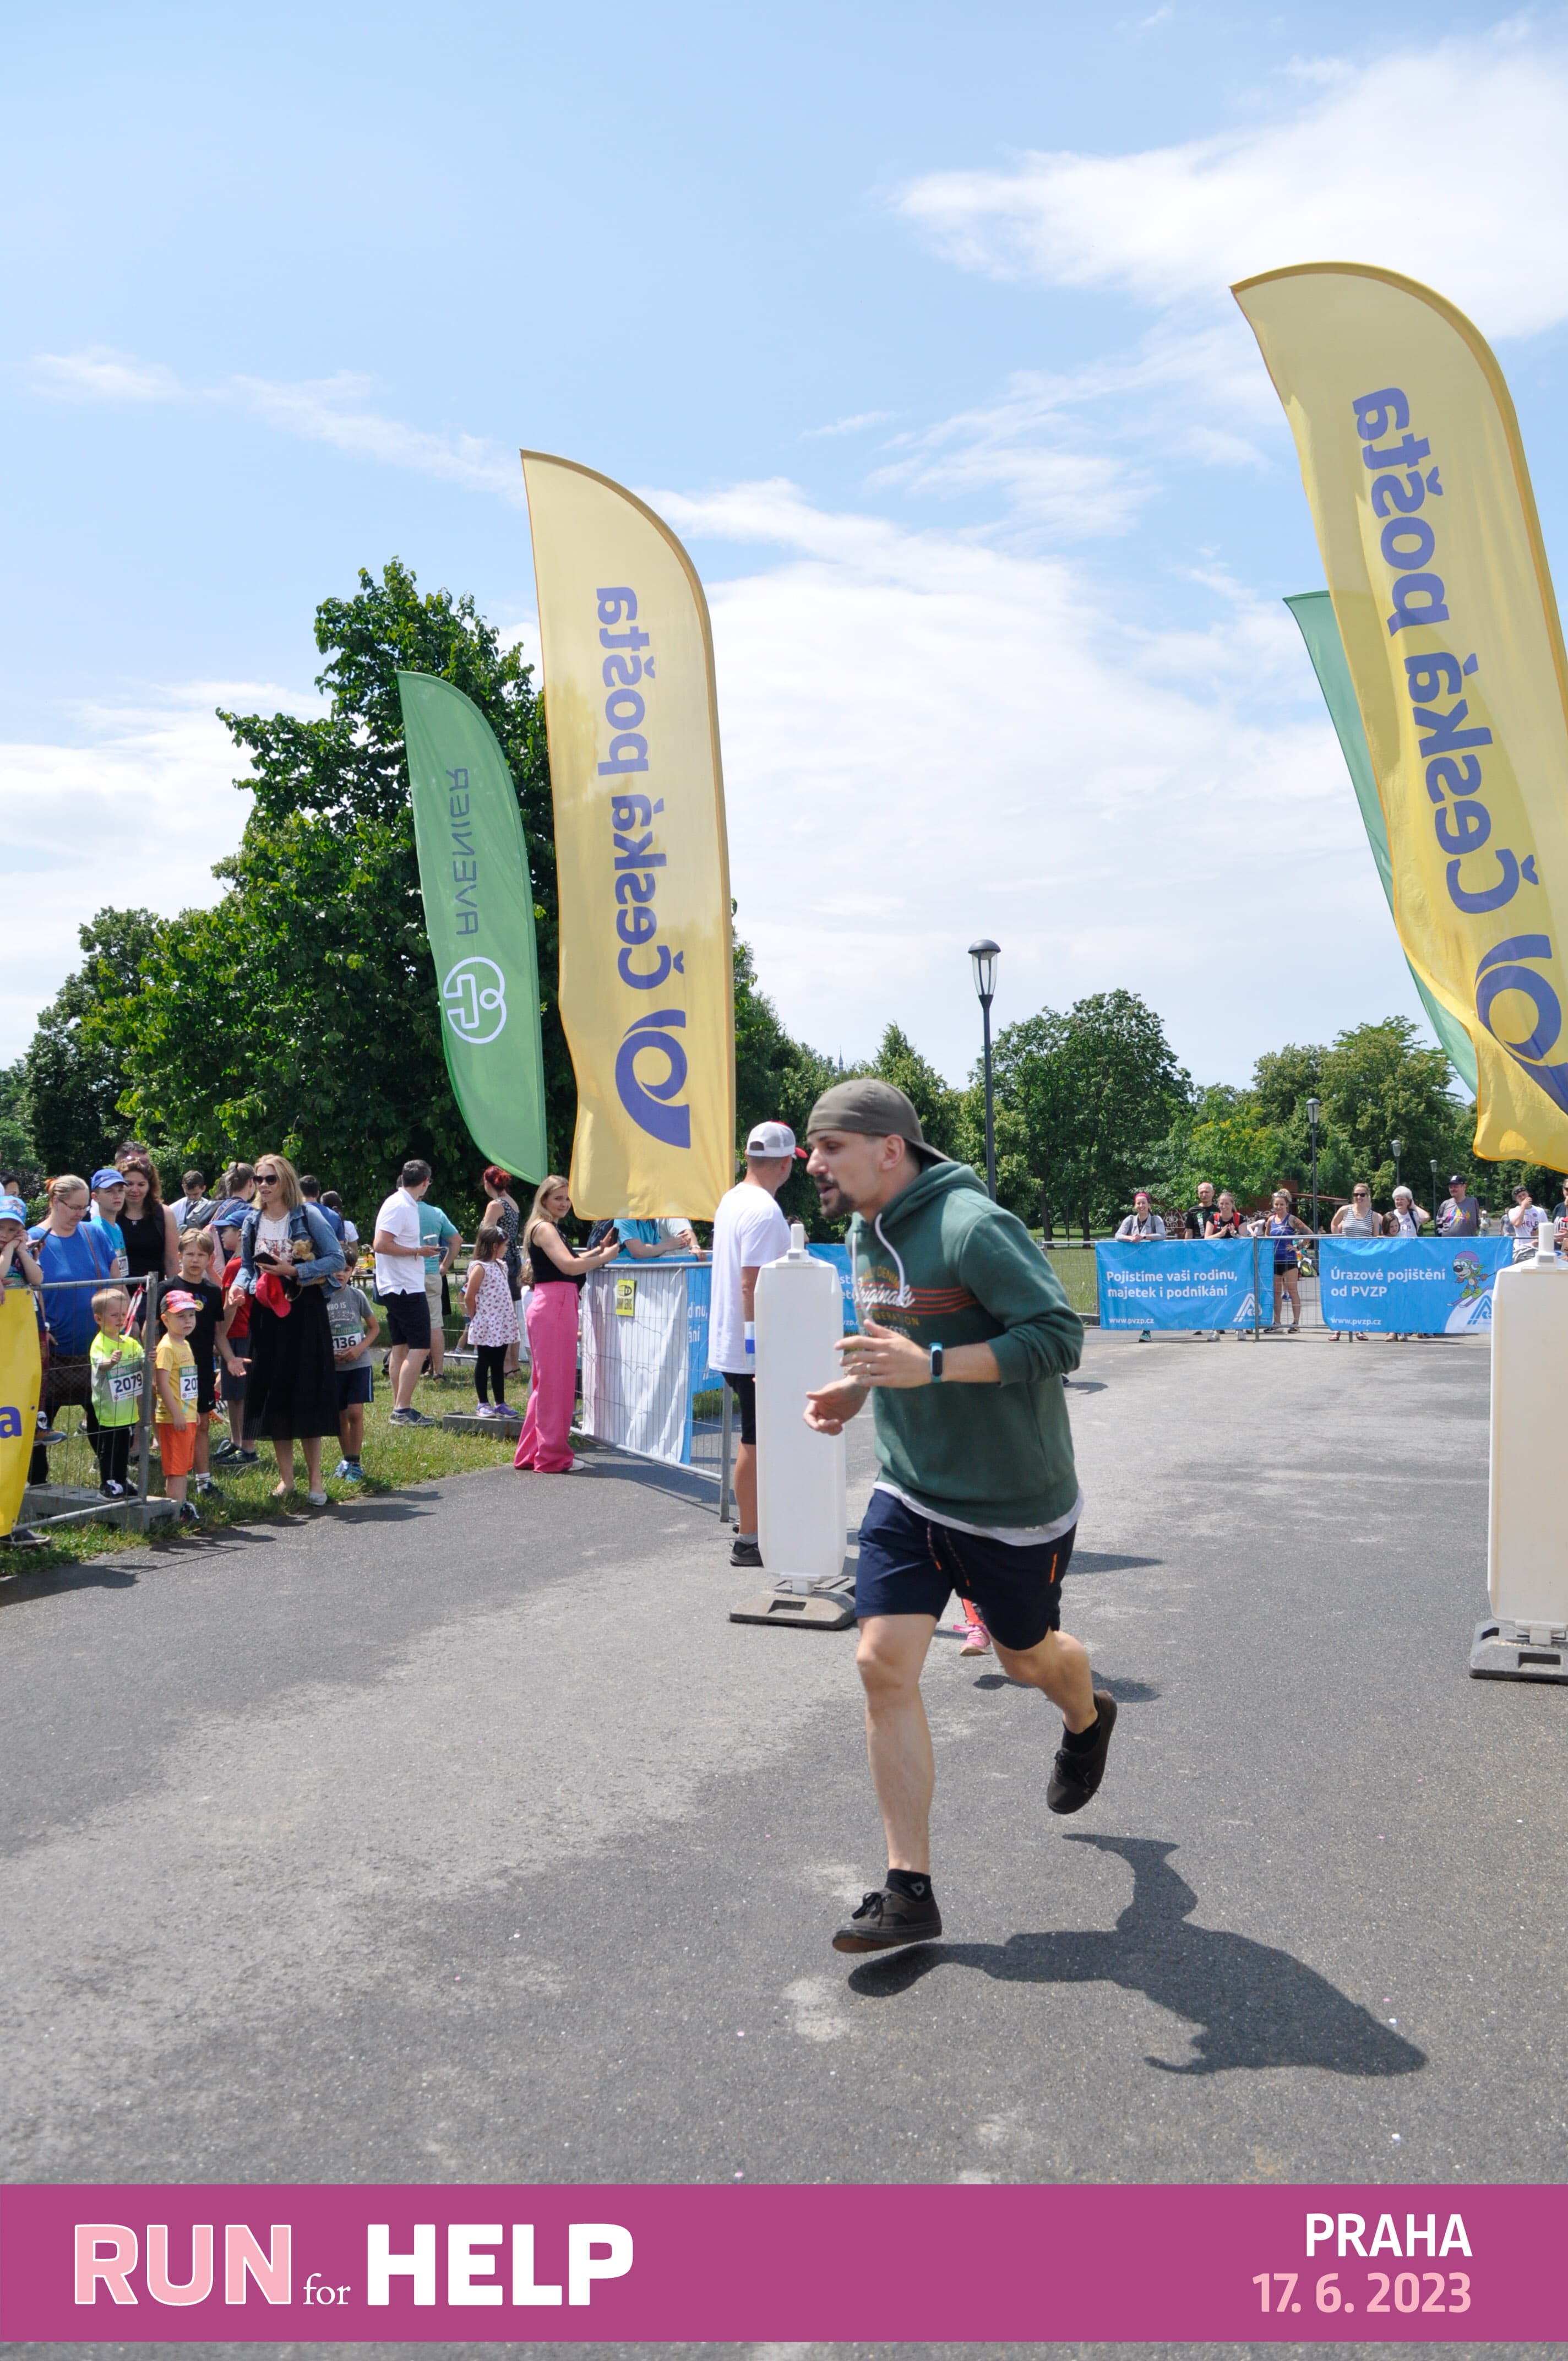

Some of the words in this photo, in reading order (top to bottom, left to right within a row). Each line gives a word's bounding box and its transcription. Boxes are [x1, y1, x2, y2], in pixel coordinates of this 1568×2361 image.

[1106, 1270, 1163, 1284] Pojistíme
[1167, 1270, 1190, 1282] vaši
[1194, 1269, 1238, 1282] rodinu,
[1330, 1266, 1384, 1281] Úrazové
[1387, 1268, 1446, 1282] pojištění
[1107, 1287, 1156, 1300] majetek
[1159, 1287, 1163, 1297] i
[1167, 1285, 1228, 1299] podnikání
[1330, 1285, 1347, 1297] od
[1351, 1286, 1387, 1297] PVZP
[333, 1335, 356, 1349] 136
[114, 1374, 143, 1393] 2079
